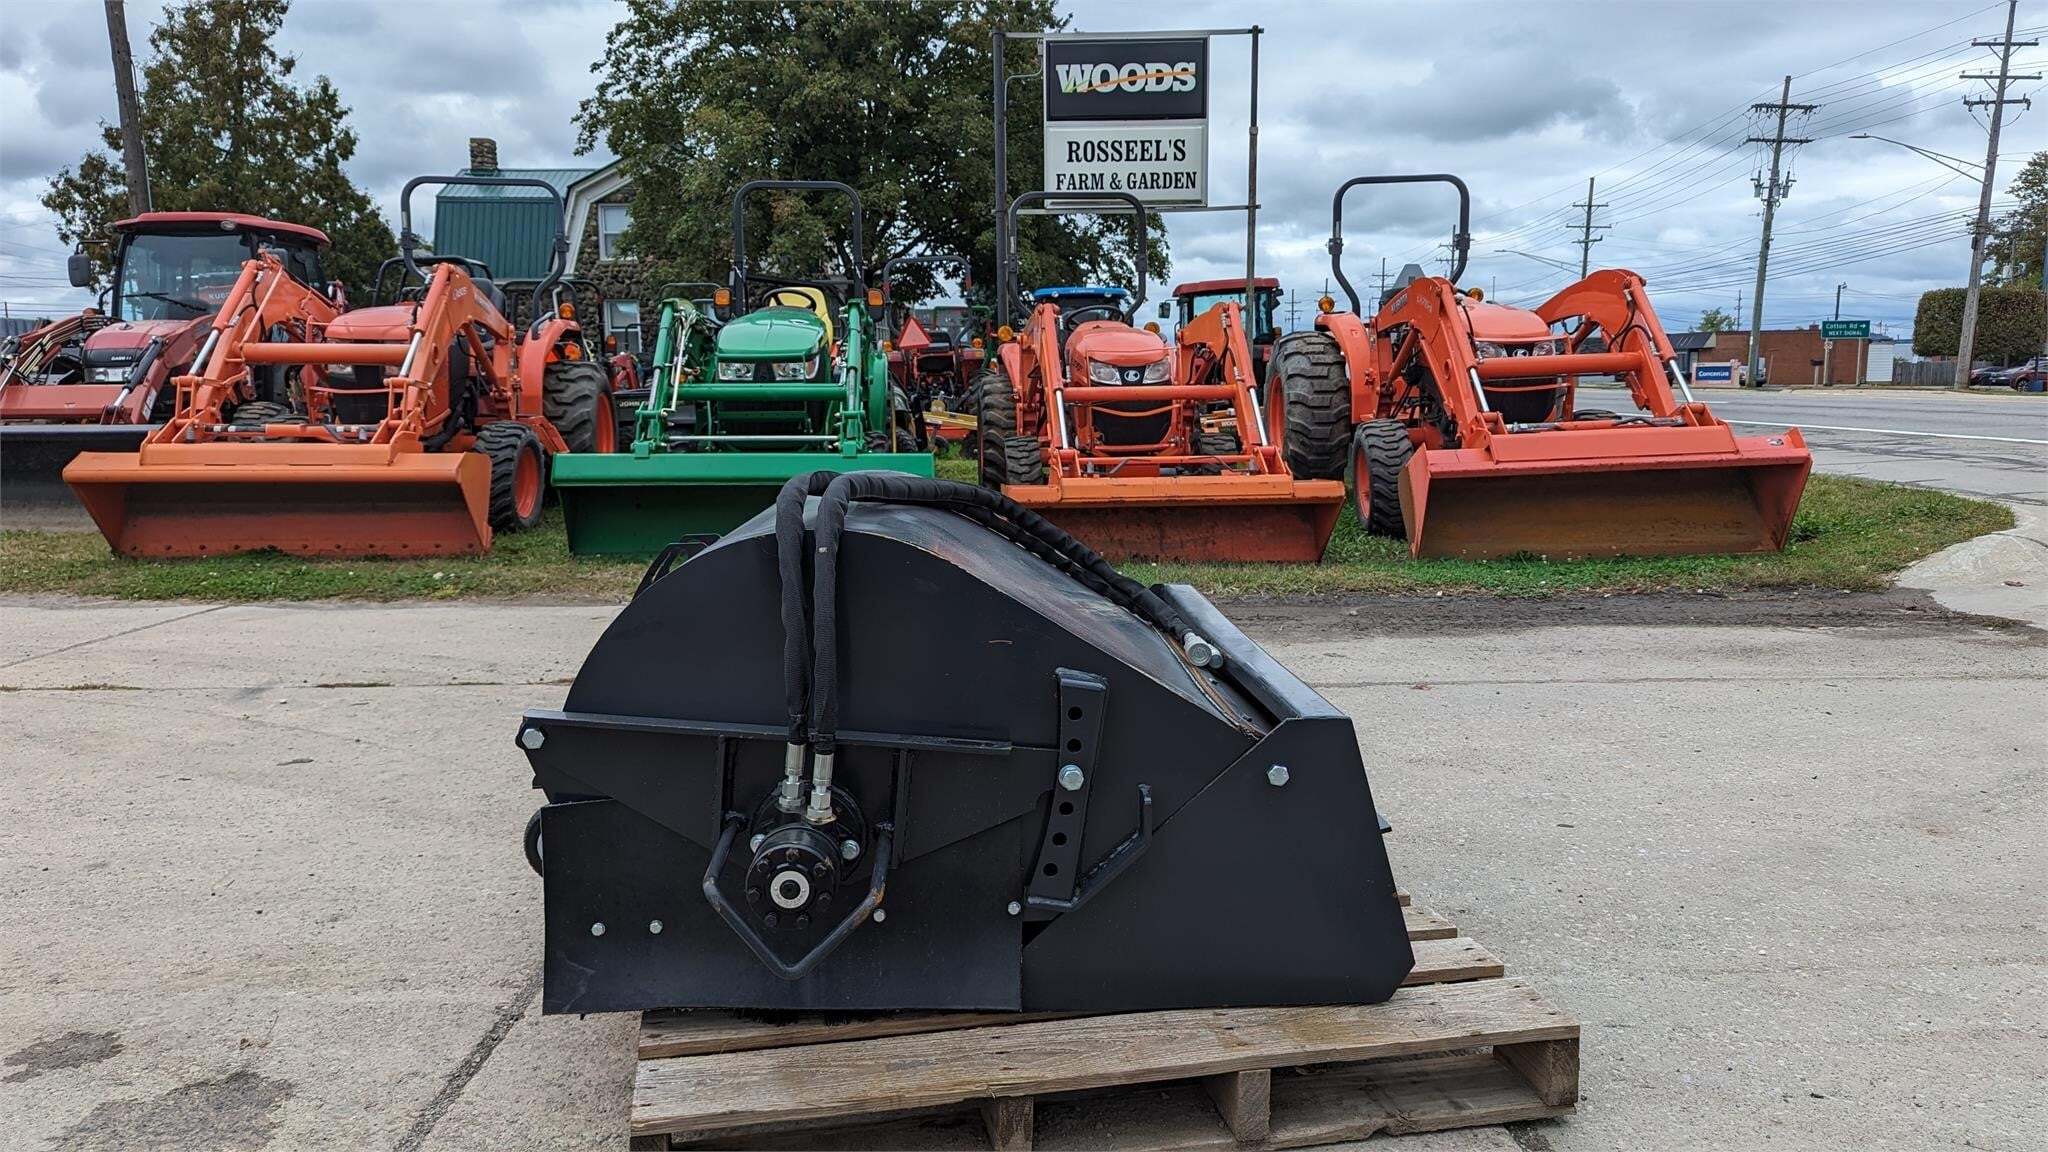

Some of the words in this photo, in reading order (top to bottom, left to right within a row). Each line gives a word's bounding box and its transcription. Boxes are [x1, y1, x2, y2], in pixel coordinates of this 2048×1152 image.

[1056, 62, 1196, 94] WOODS
[1066, 139, 1187, 163] ROSSEEL'S
[1056, 173, 1105, 191] FARM
[1109, 172, 1122, 190] &
[1126, 171, 1197, 190] GARDEN
